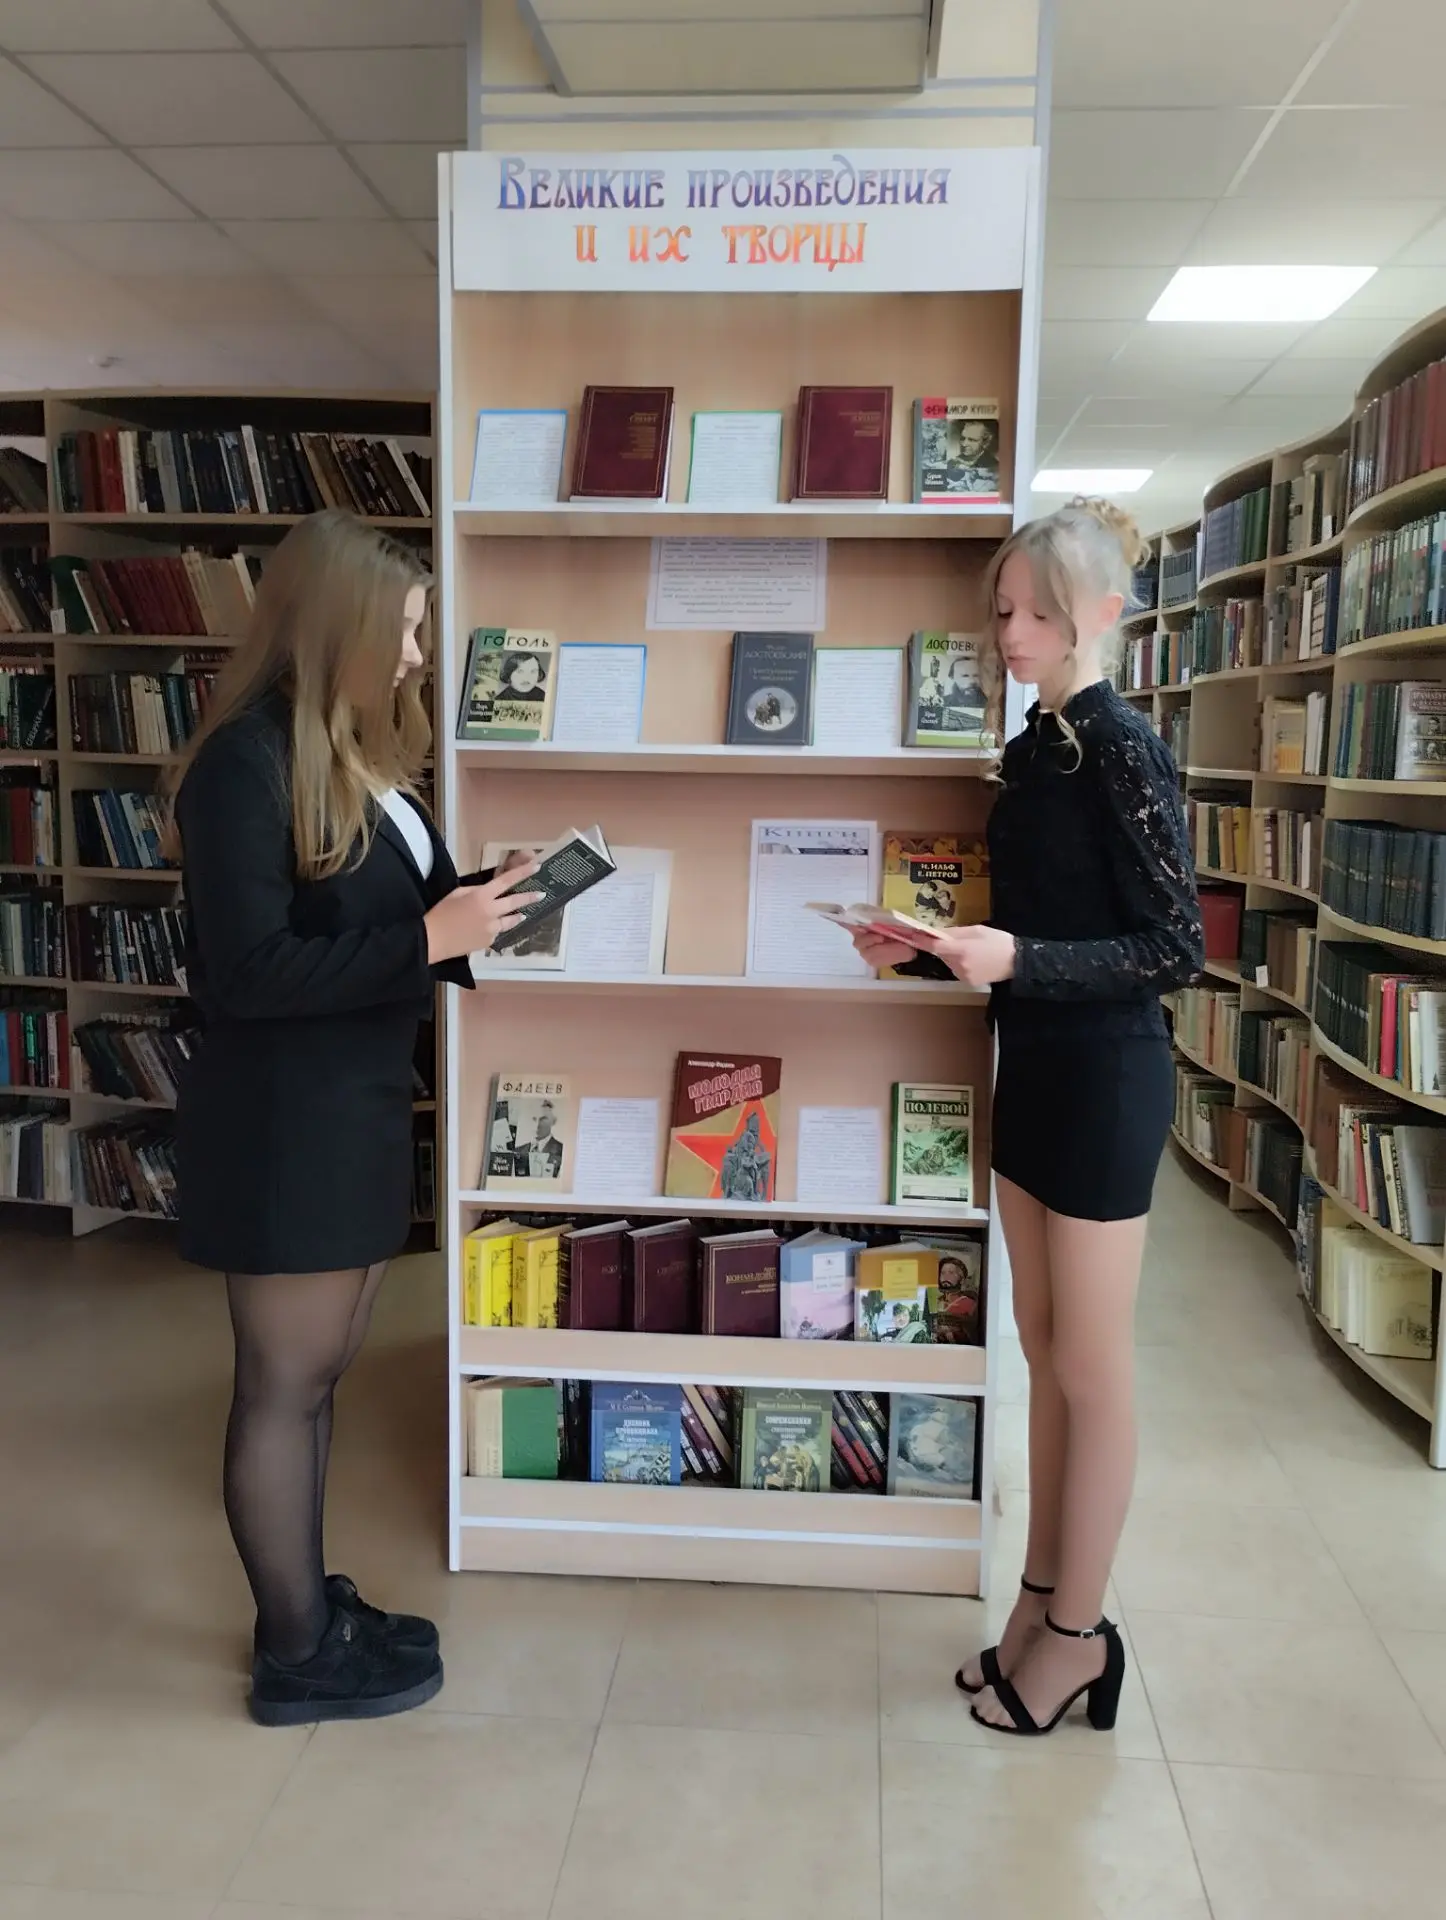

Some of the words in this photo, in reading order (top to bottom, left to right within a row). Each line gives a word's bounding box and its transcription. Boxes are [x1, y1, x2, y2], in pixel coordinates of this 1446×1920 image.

[483, 635, 549, 648] ГОГОЛЬ
[930, 863, 956, 871] ИЛЬФ
[503, 1082, 563, 1094] ФАДЕЕВ
[688, 1064, 762, 1100] МОЛОДАЯ
[694, 1080, 763, 1114] ГВАРДИЯ
[905, 1101, 968, 1115] ПОЛЕВОЙ
